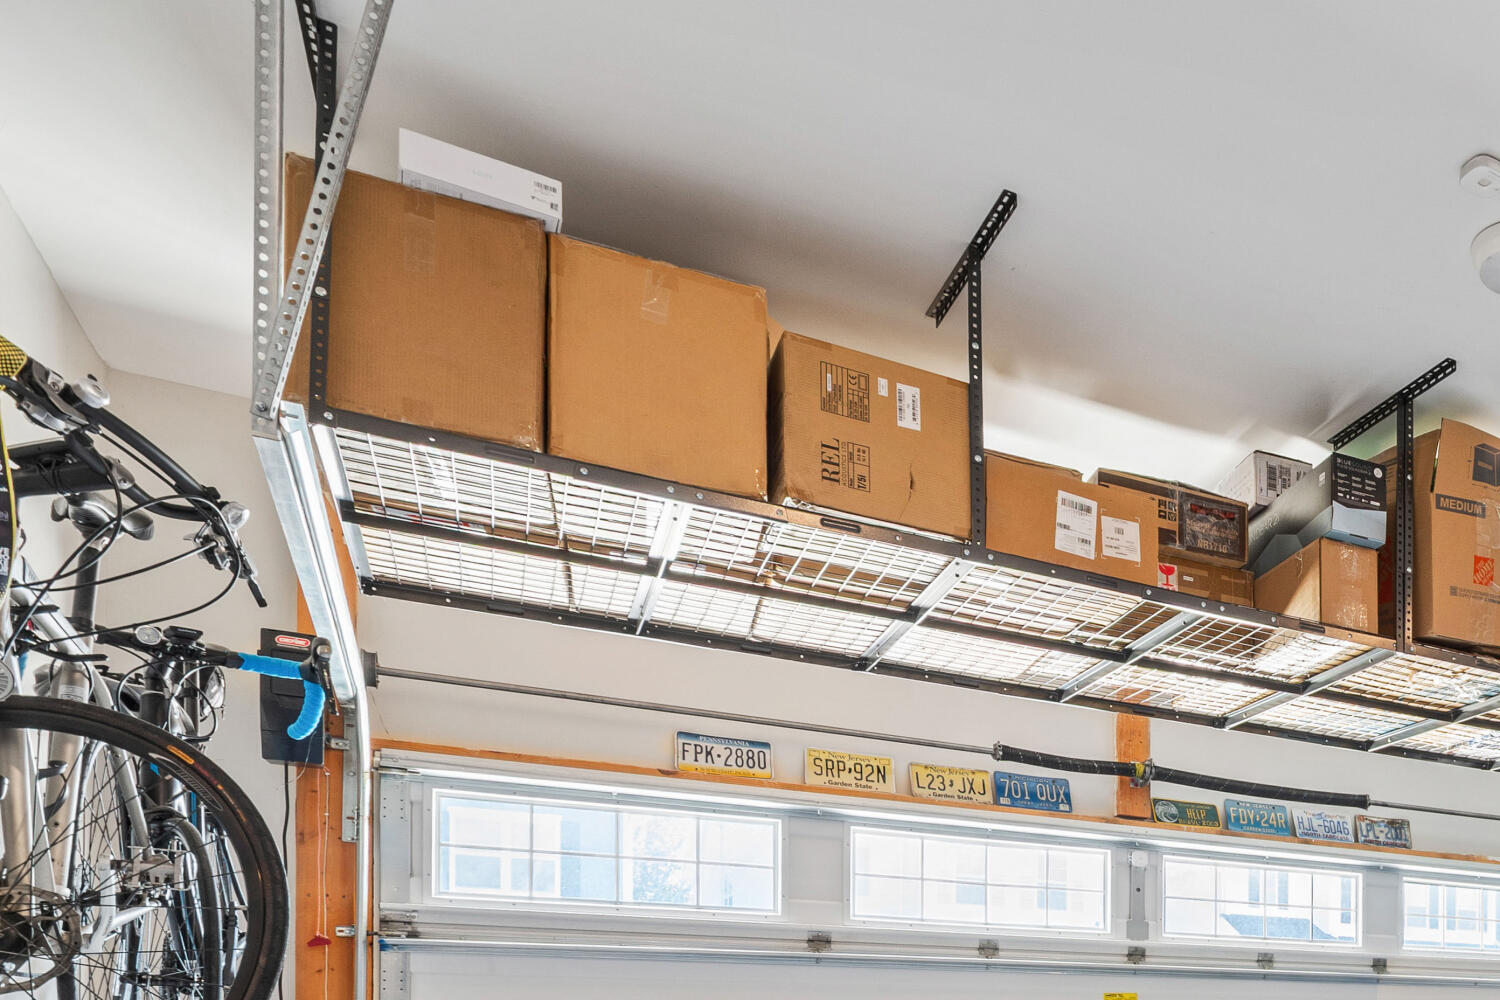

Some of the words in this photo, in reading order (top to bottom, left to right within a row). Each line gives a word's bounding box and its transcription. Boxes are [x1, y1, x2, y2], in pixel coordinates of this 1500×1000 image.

[820, 437, 840, 486] REL
[1439, 497, 1482, 515] MEDIUM
[699, 735, 750, 748] PENNSYLVANIA
[828, 752, 846, 761] New
[848, 754, 871, 763] Jersey
[929, 766, 948, 774] New
[949, 768, 971, 777] Jersey
[827, 779, 853, 788] Garden
[854, 782, 873, 790] State
[1014, 775, 1050, 784] MICHIGAN
[932, 792, 955, 800] Garden
[956, 794, 974, 802] State
[1000, 778, 1031, 800] 701
[1036, 782, 1068, 804] QUX
[1297, 815, 1350, 836] HJL-6046
